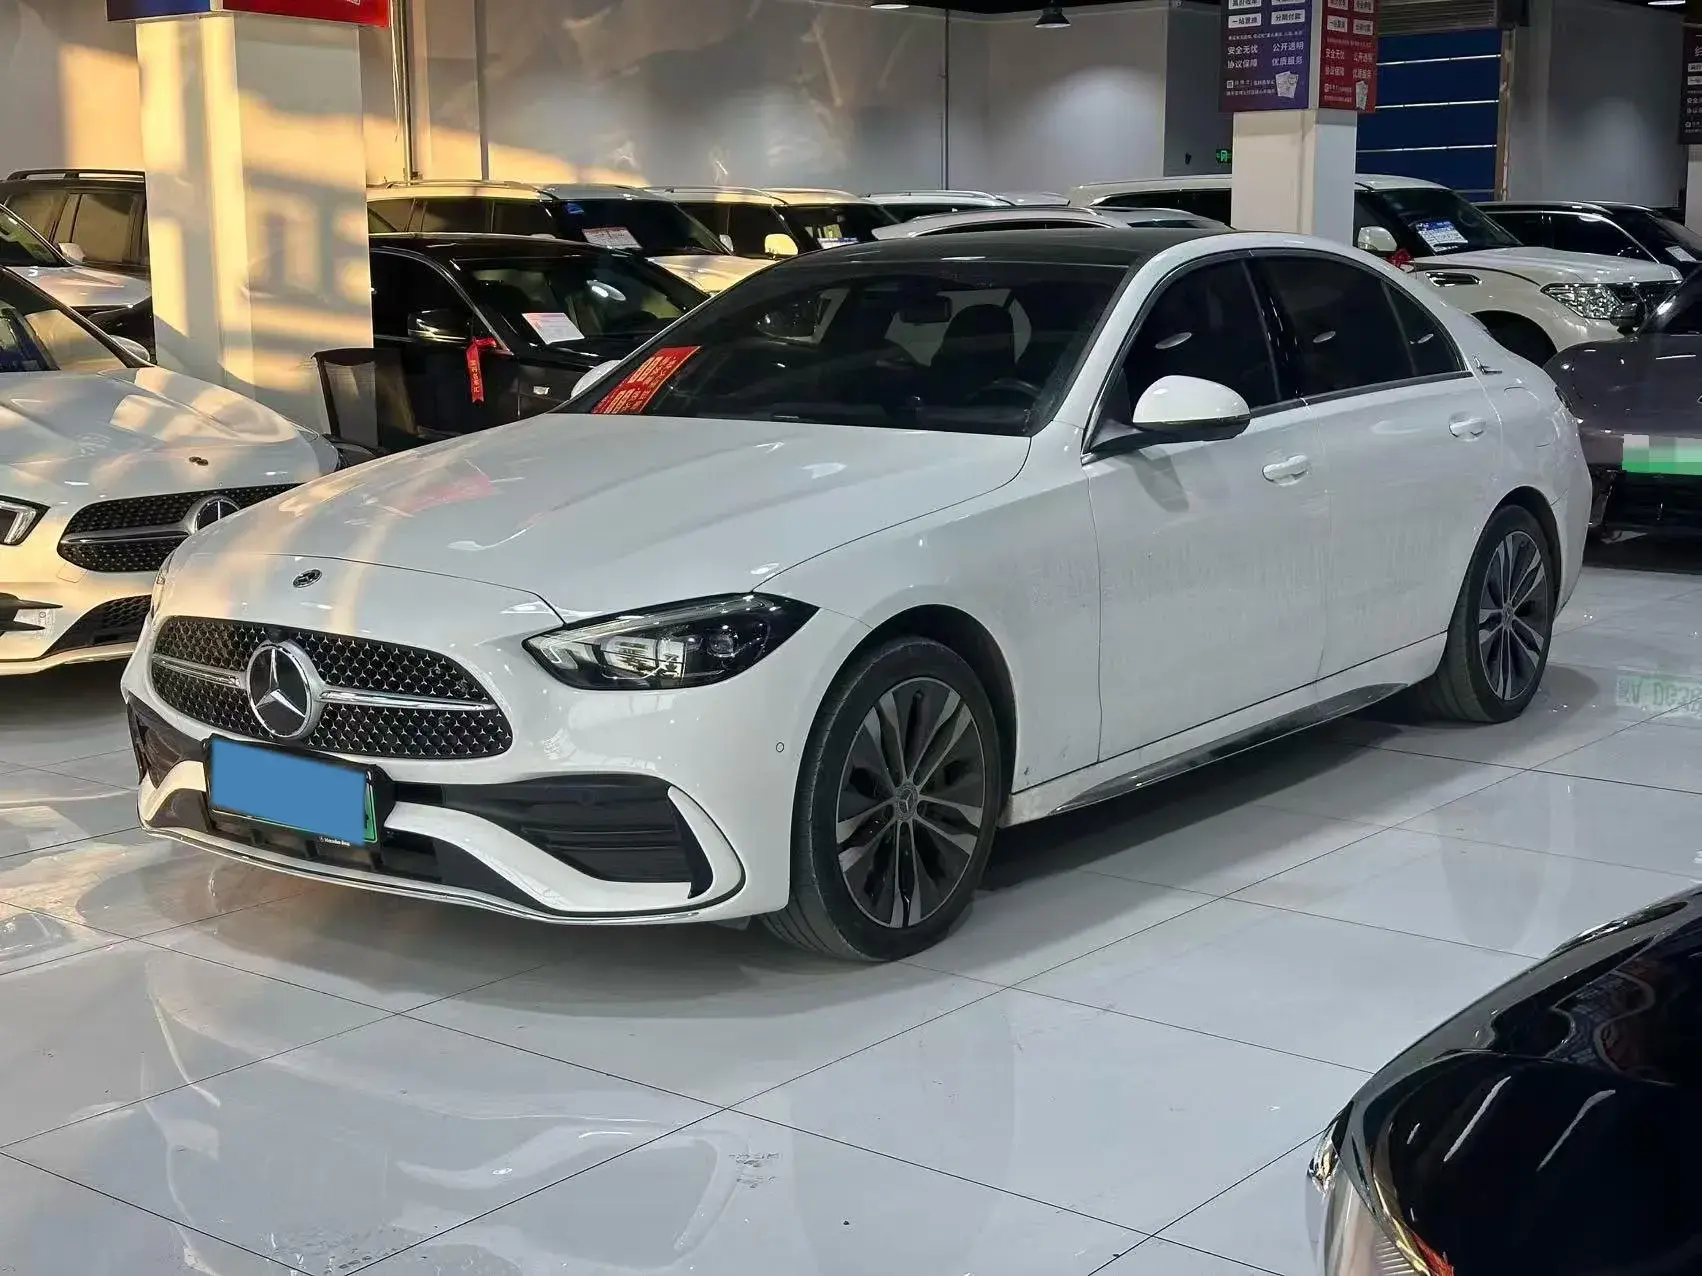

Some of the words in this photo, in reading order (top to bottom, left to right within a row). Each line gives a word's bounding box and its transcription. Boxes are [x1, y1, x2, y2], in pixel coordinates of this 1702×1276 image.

[1275, 12, 1302, 22] 分期付款
[1227, 44, 1259, 55] 安全无忧
[1272, 41, 1304, 52] 公开透明
[1227, 58, 1258, 69] 协议保障
[1271, 56, 1303, 67] 优质服务
